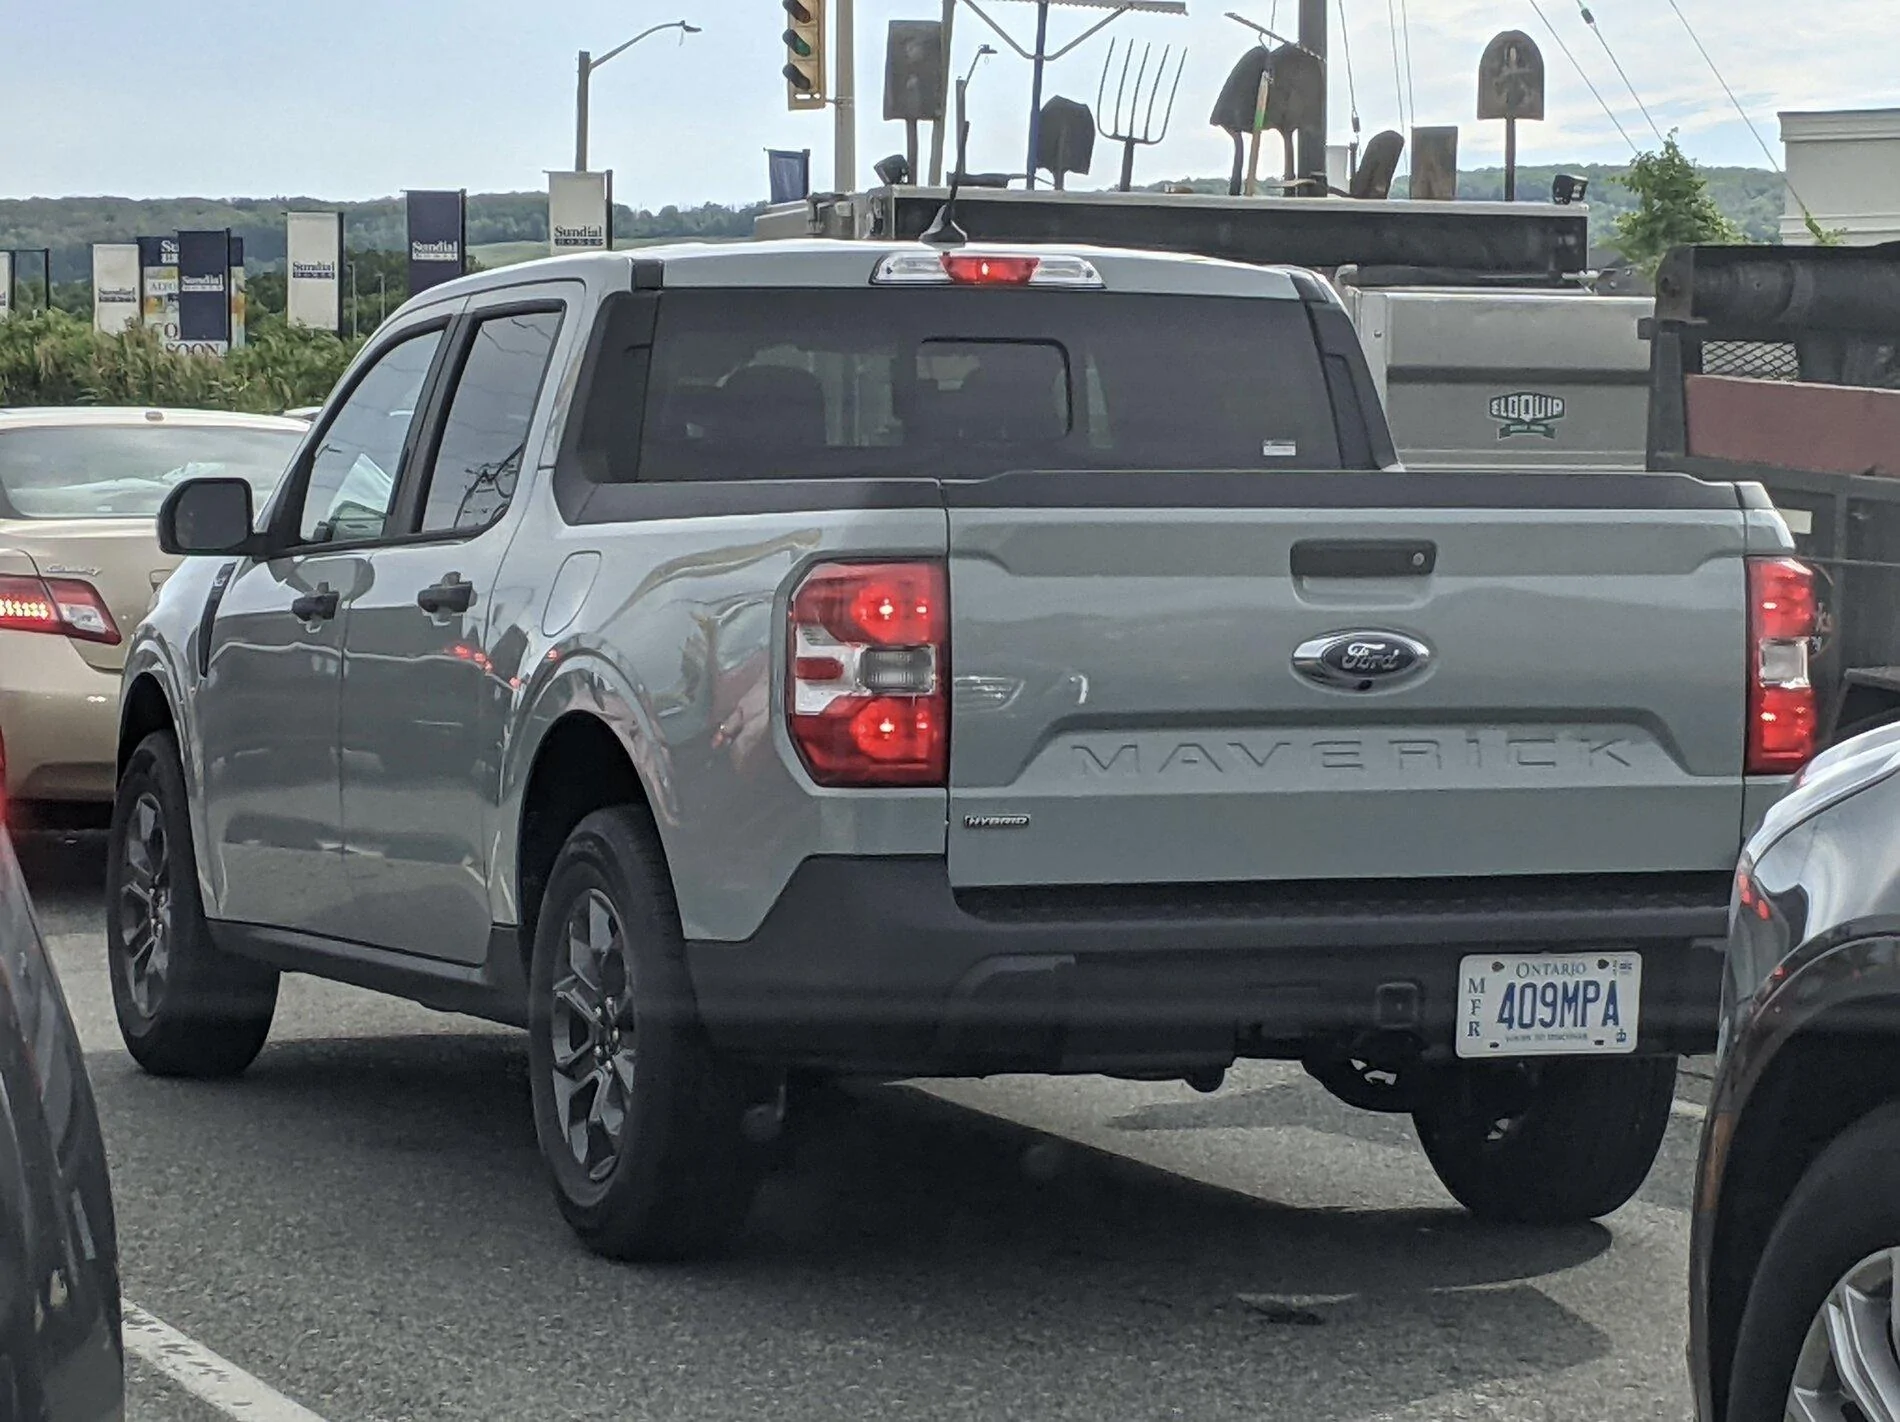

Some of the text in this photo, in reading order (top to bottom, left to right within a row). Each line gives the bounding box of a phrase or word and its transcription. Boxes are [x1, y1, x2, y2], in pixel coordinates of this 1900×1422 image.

[554, 225, 603, 237] Sundial
[412, 240, 458, 253] Sundial
[1491, 394, 1564, 422] ELOQUIP
[1341, 642, 1400, 669] Ford
[1071, 738, 1631, 774] MAVERICK
[1515, 961, 1588, 979] ONTARIO
[1497, 979, 1620, 1030] 409MPA
